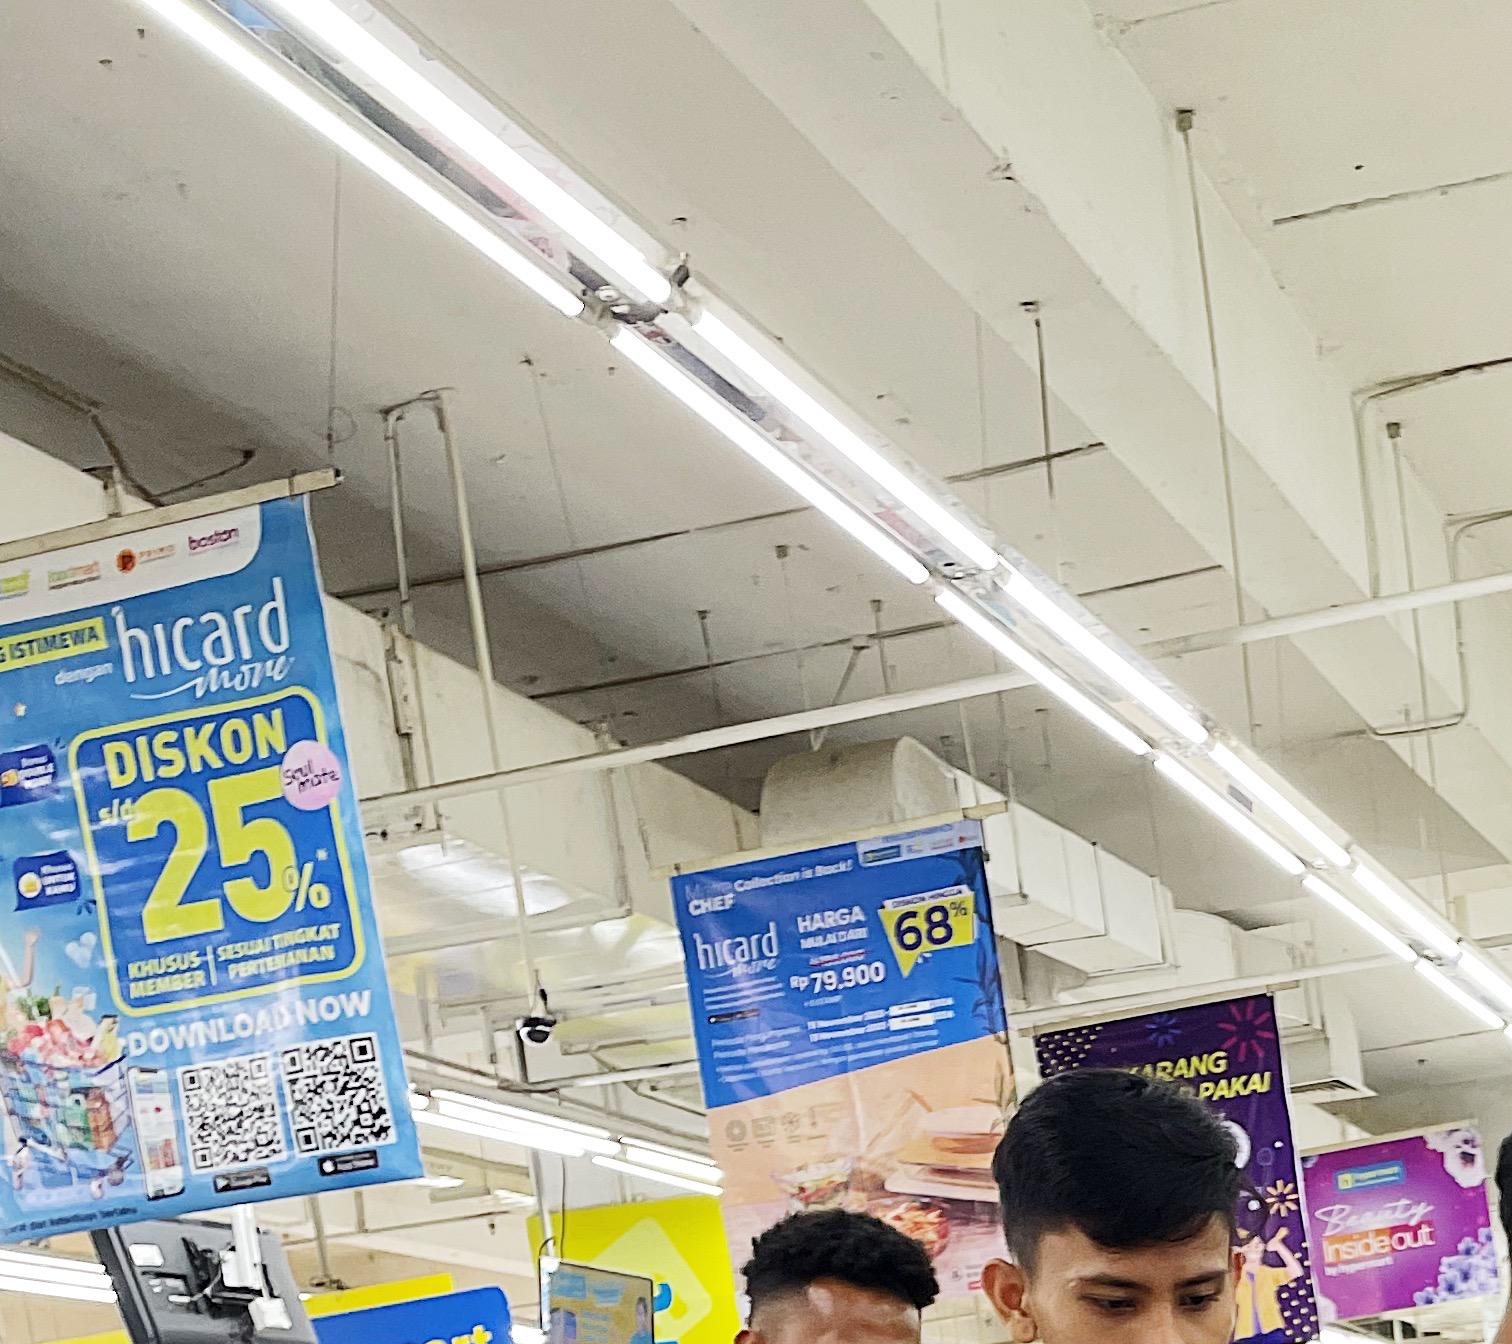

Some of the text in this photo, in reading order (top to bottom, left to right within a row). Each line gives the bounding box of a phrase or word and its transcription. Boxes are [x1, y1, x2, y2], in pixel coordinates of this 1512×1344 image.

[9, 625, 100, 661] ISTIMEWA
[112, 576, 290, 683] hicard
[102, 707, 286, 788] DISKON
[733, 869, 800, 892] Collection
[688, 892, 735, 916] CHEF
[796, 904, 866, 933] HARGA
[127, 950, 202, 979] KHUSUS
[129, 970, 206, 999] MEMBER
[126, 988, 373, 1058] DOWNLOAD NOW
[1128, 1050, 1229, 1083] ARANG
[1199, 1071, 1272, 1101] PAKAI
[1391, 1224, 1436, 1252] out
